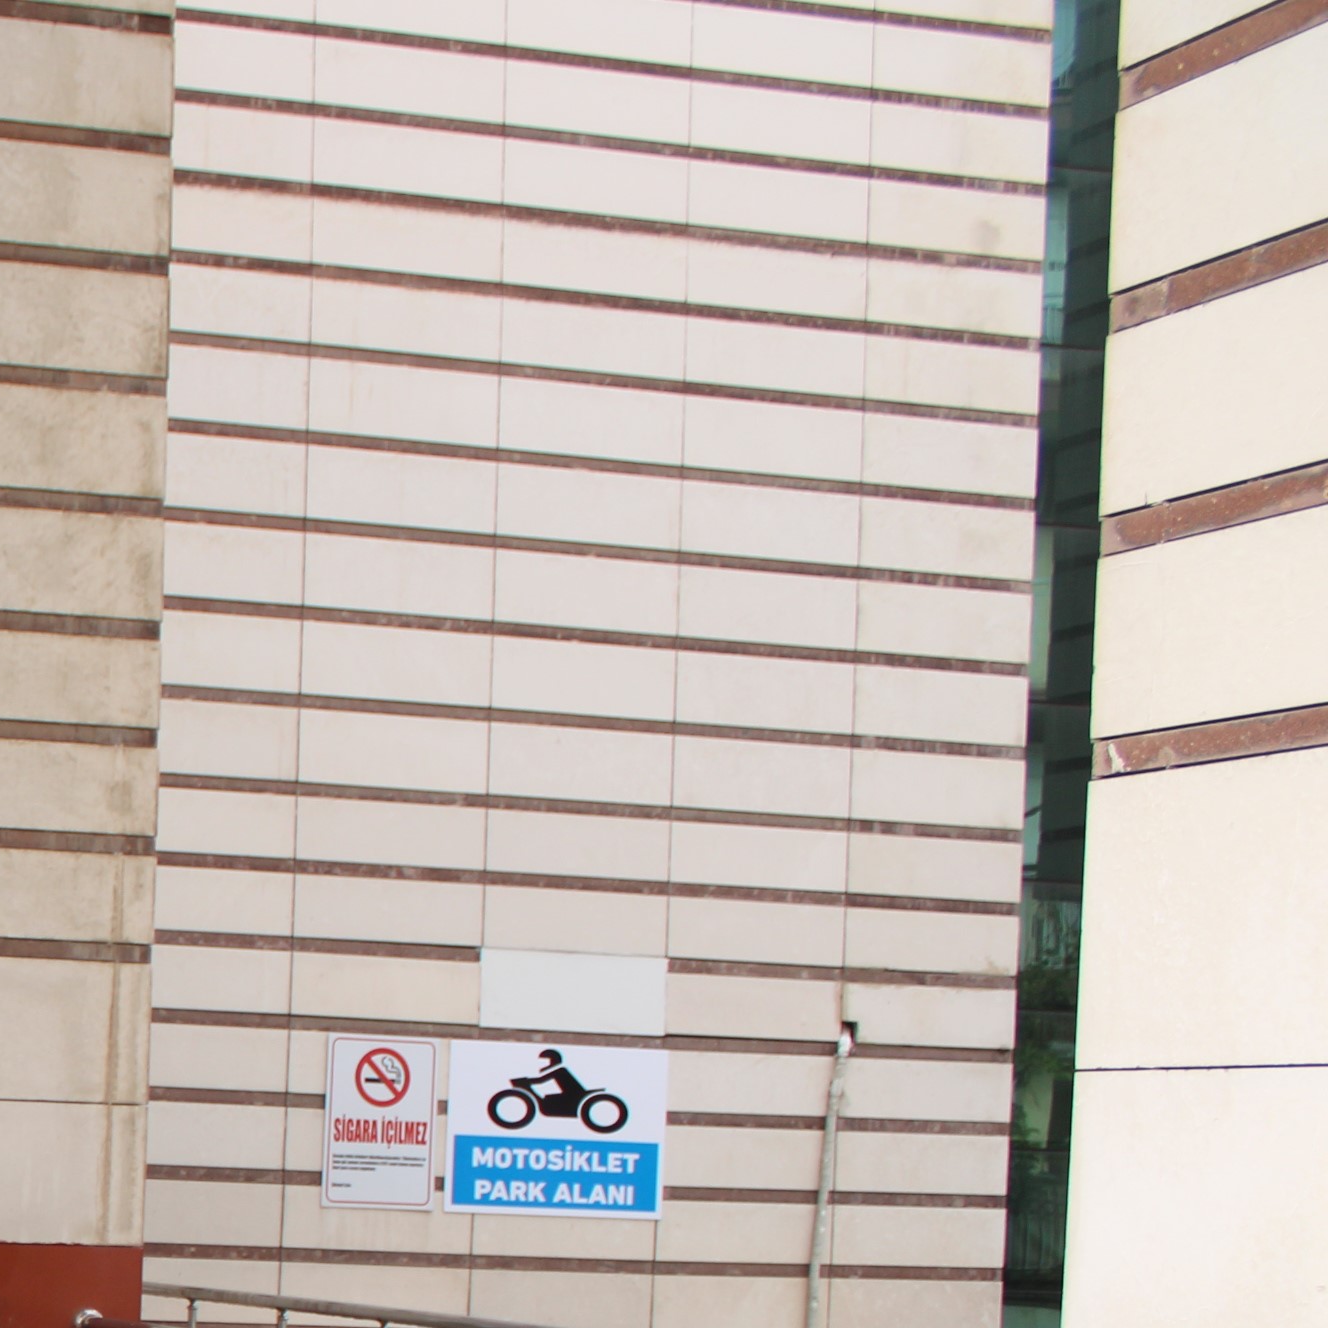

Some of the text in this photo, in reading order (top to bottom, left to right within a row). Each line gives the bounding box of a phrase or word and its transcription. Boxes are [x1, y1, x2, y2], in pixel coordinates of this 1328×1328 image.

[333, 1114, 428, 1149] SİGARA İÇİLMEZ
[471, 1145, 640, 1174] MOTOSİKLET
[473, 1179, 636, 1206] PARK ALANI
